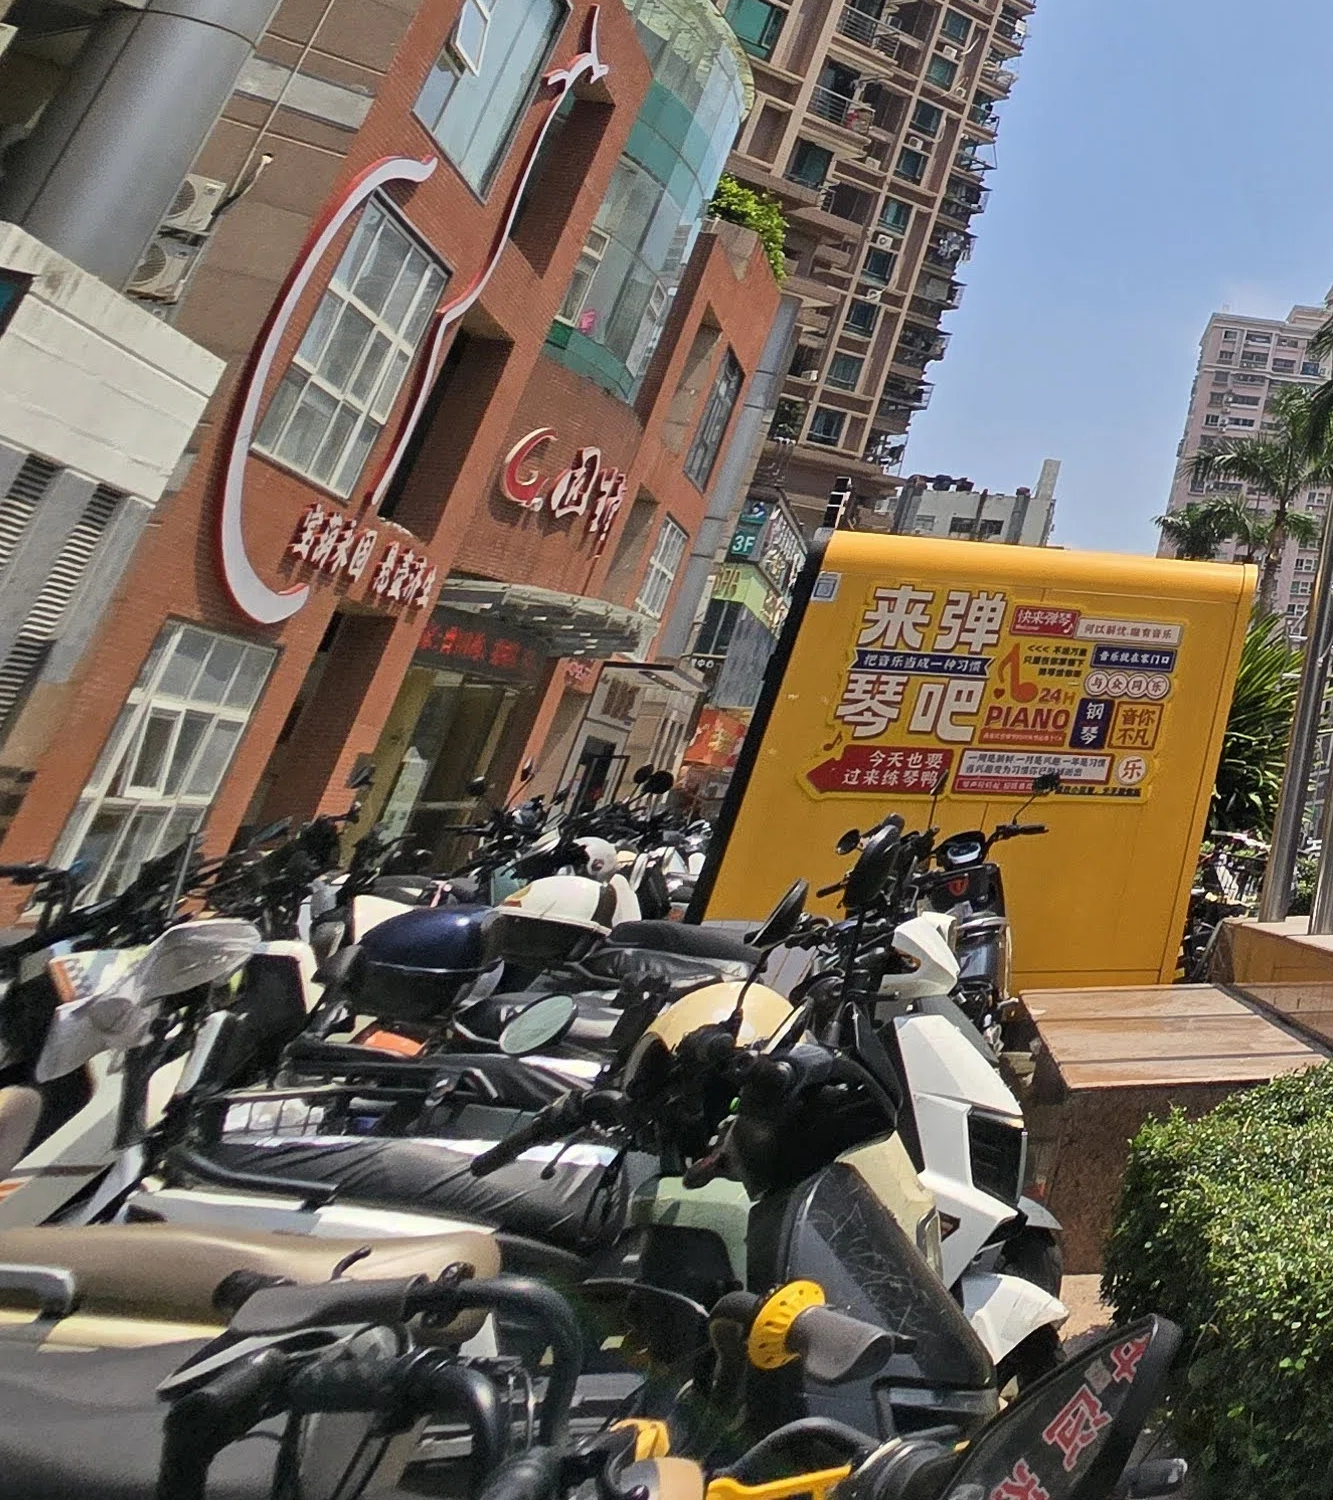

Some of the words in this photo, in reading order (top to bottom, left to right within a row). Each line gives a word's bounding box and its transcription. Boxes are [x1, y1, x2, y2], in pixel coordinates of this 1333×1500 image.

[731, 535, 756, 553] 3F
[857, 585, 1008, 653] 来弹
[863, 654, 983, 673] 把音乐当成一种习惯
[835, 672, 988, 742] 琴吧
[984, 705, 1071, 731] PIANO
[869, 750, 944, 770] 今天也要
